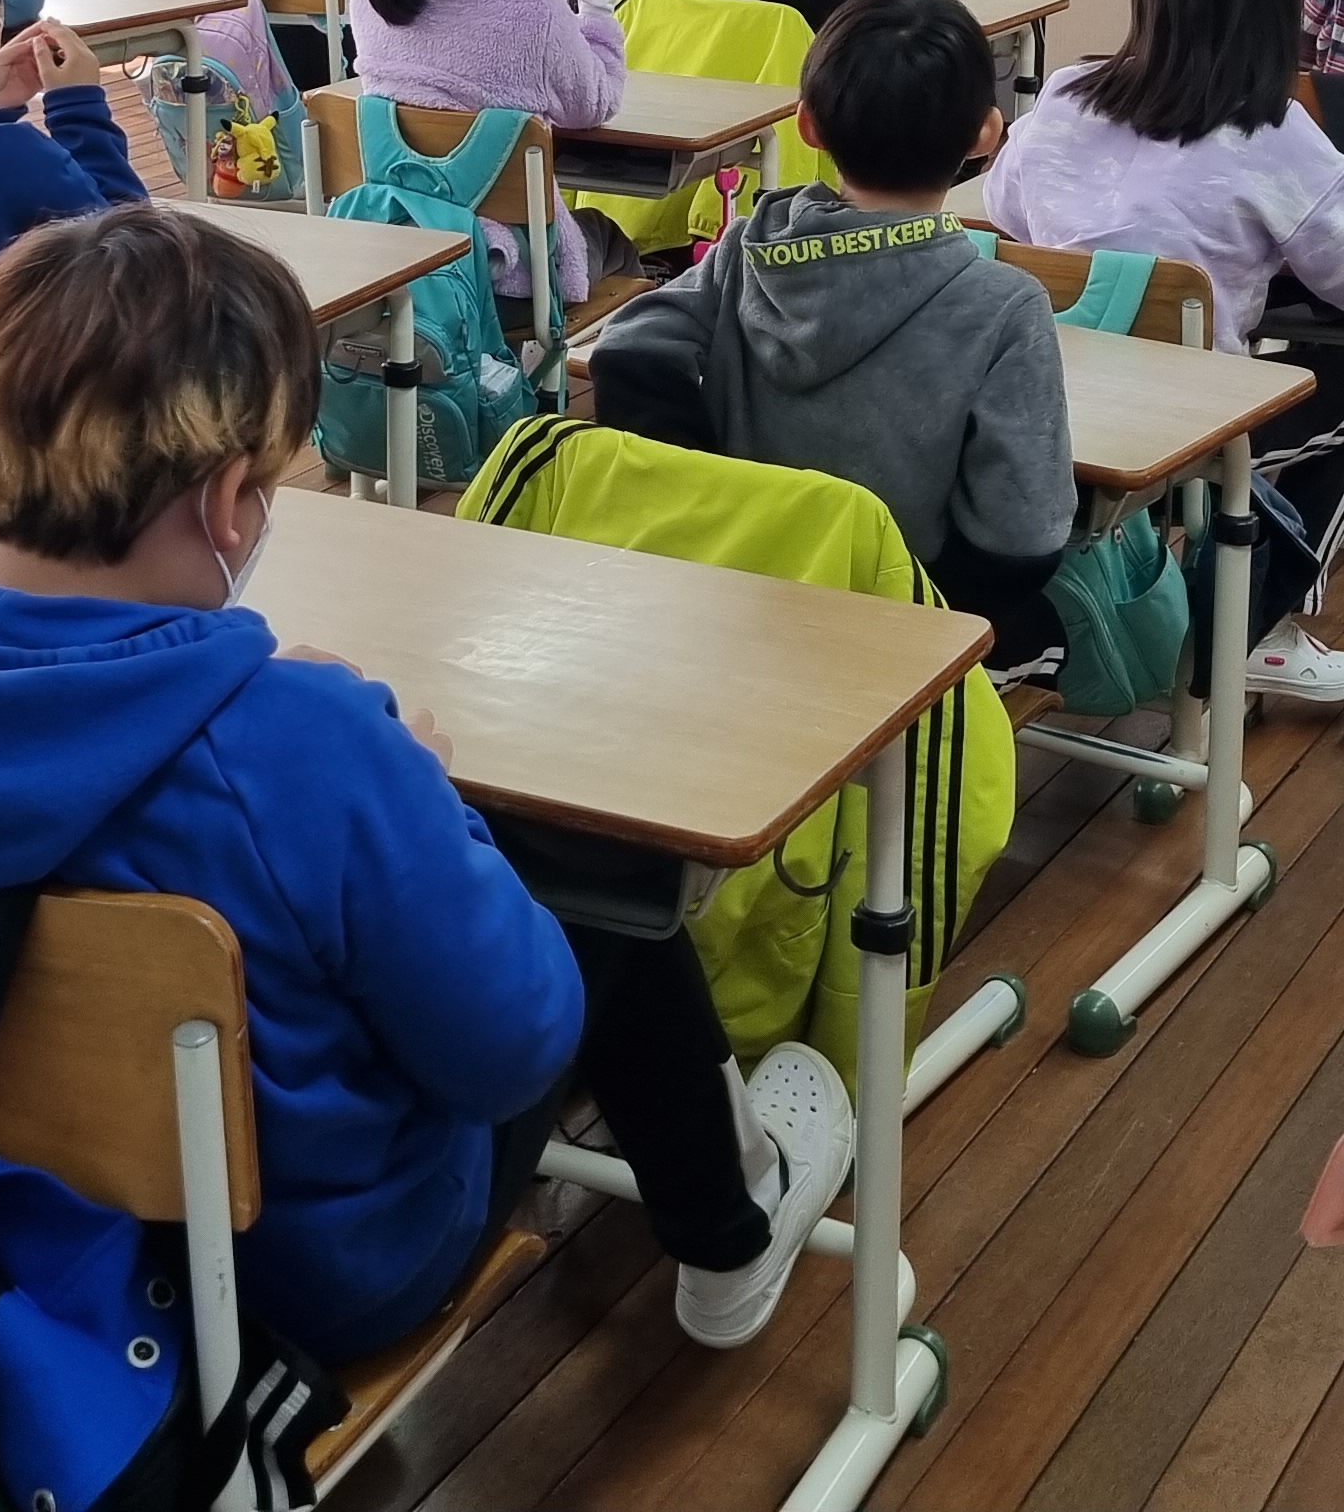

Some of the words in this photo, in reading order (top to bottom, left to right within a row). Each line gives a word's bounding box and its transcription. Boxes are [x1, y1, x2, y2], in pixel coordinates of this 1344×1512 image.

[757, 241, 827, 267] YOUR
[831, 228, 883, 256] BEST
[886, 218, 936, 248] KEEP
